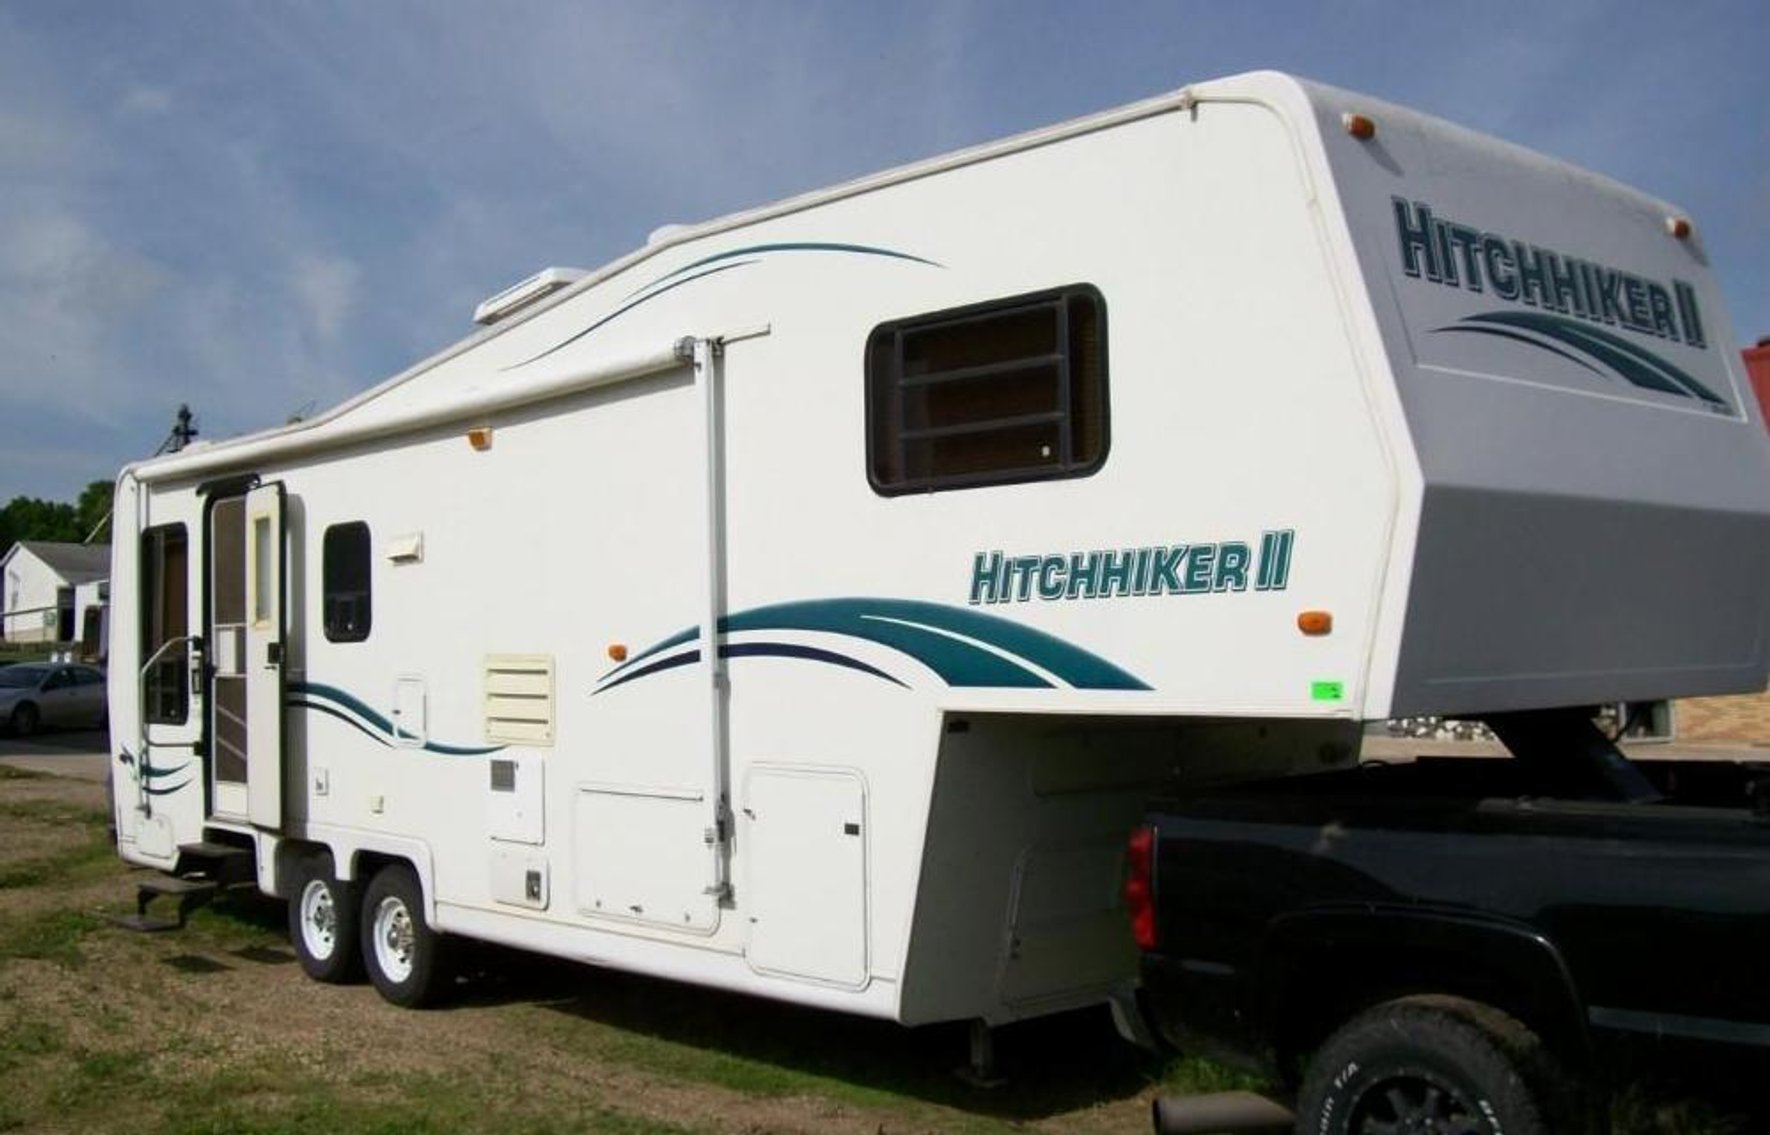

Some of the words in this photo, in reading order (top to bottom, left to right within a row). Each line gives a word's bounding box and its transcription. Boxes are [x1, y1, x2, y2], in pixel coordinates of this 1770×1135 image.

[1391, 195, 1679, 342] HITCHHIKER
[1674, 278, 1707, 349] II
[968, 541, 1252, 605] HITCHHIKER
[1255, 528, 1295, 591] II
